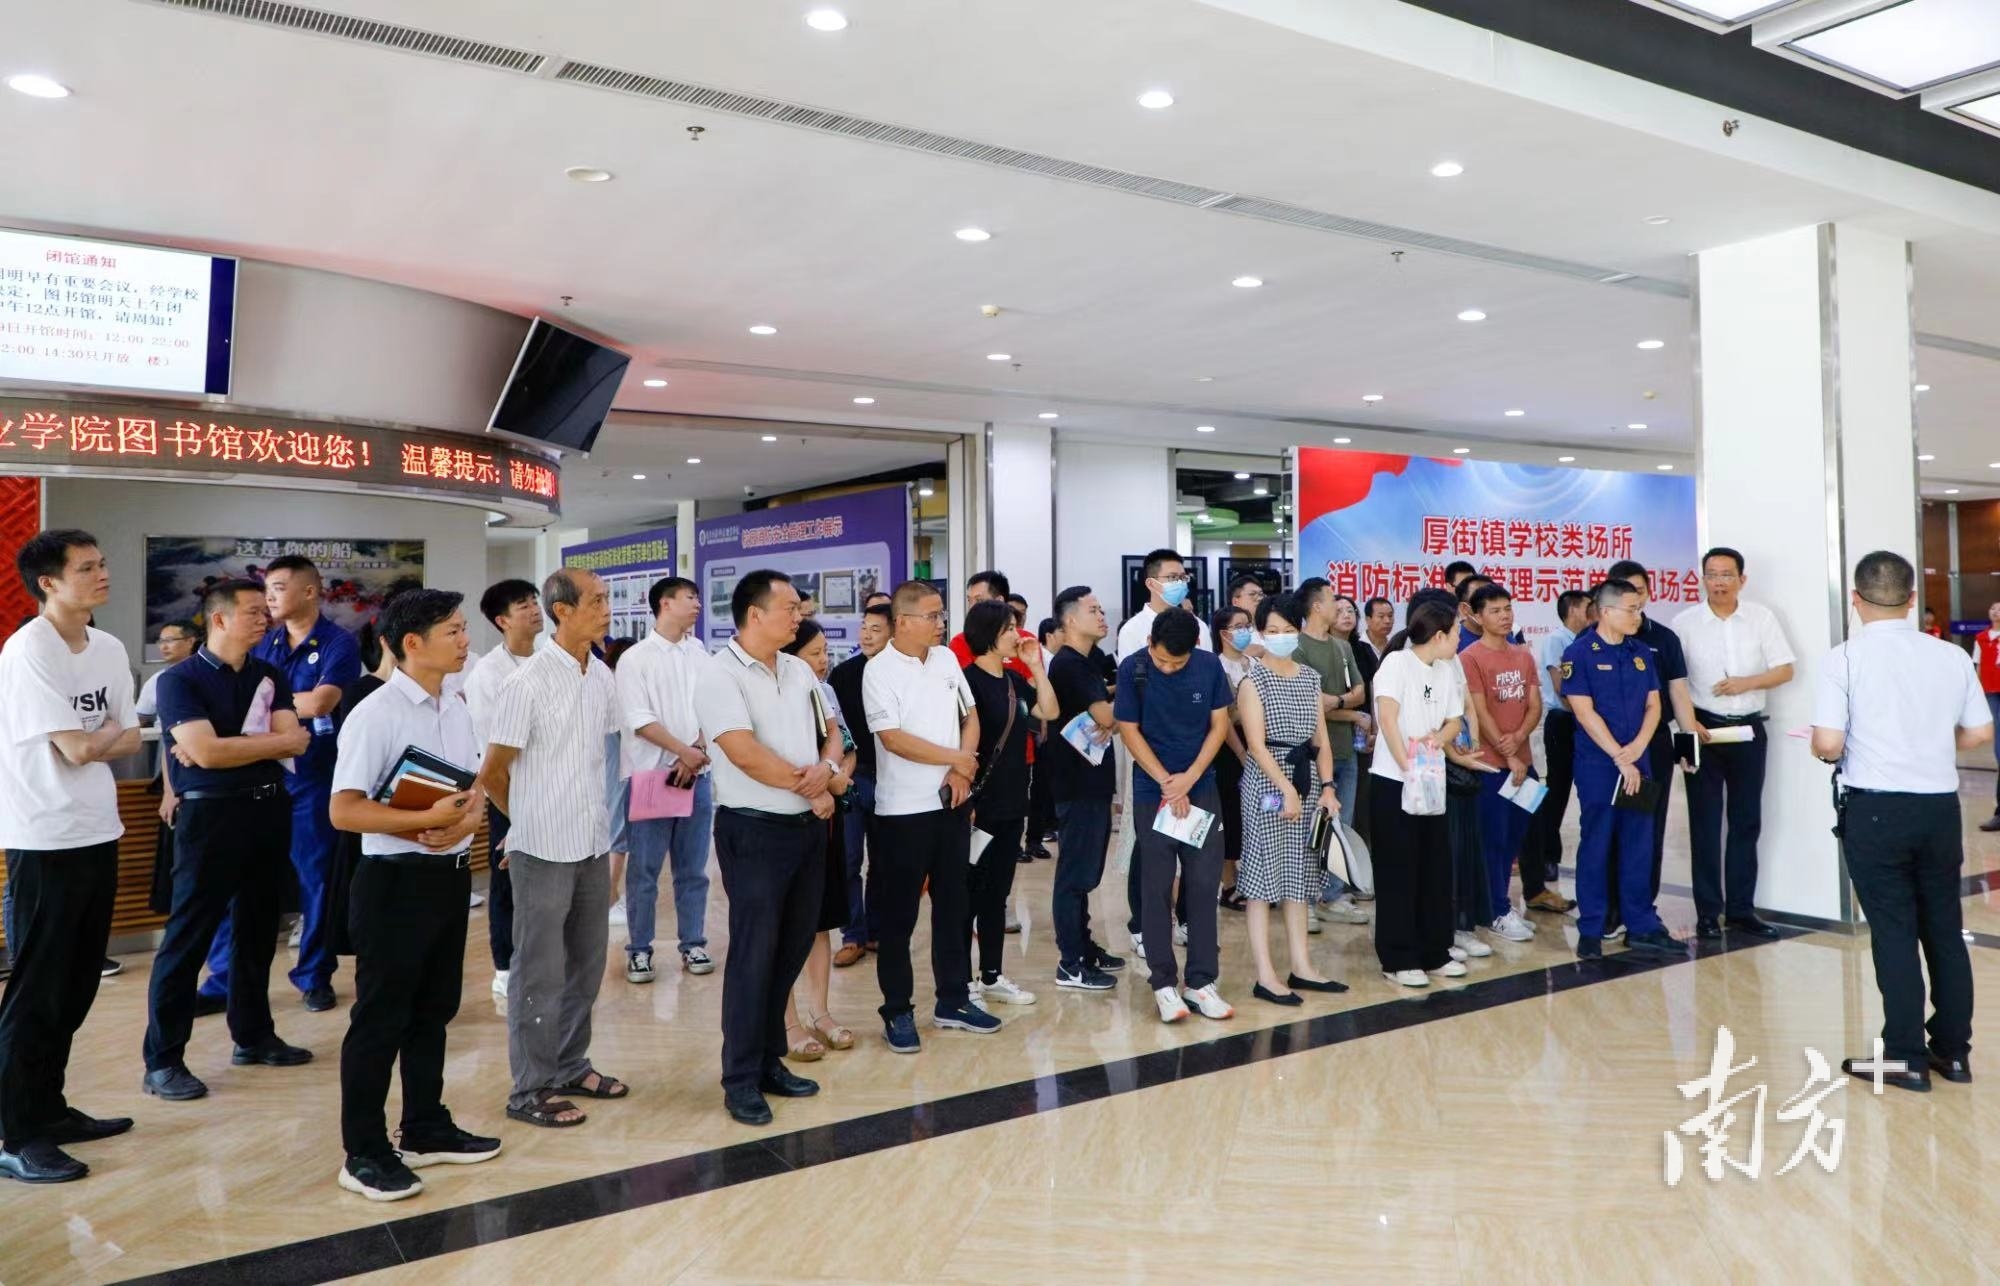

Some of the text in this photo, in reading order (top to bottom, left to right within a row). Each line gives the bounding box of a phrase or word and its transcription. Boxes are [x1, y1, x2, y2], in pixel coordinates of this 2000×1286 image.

[46, 249, 117, 268] 闭馆通知
[402, 443, 500, 483] 温馨提示：
[1420, 514, 1633, 559] 厚街镇学校类场所
[235, 540, 352, 558] 这是你的船
[1496, 669, 1522, 686] FRESH
